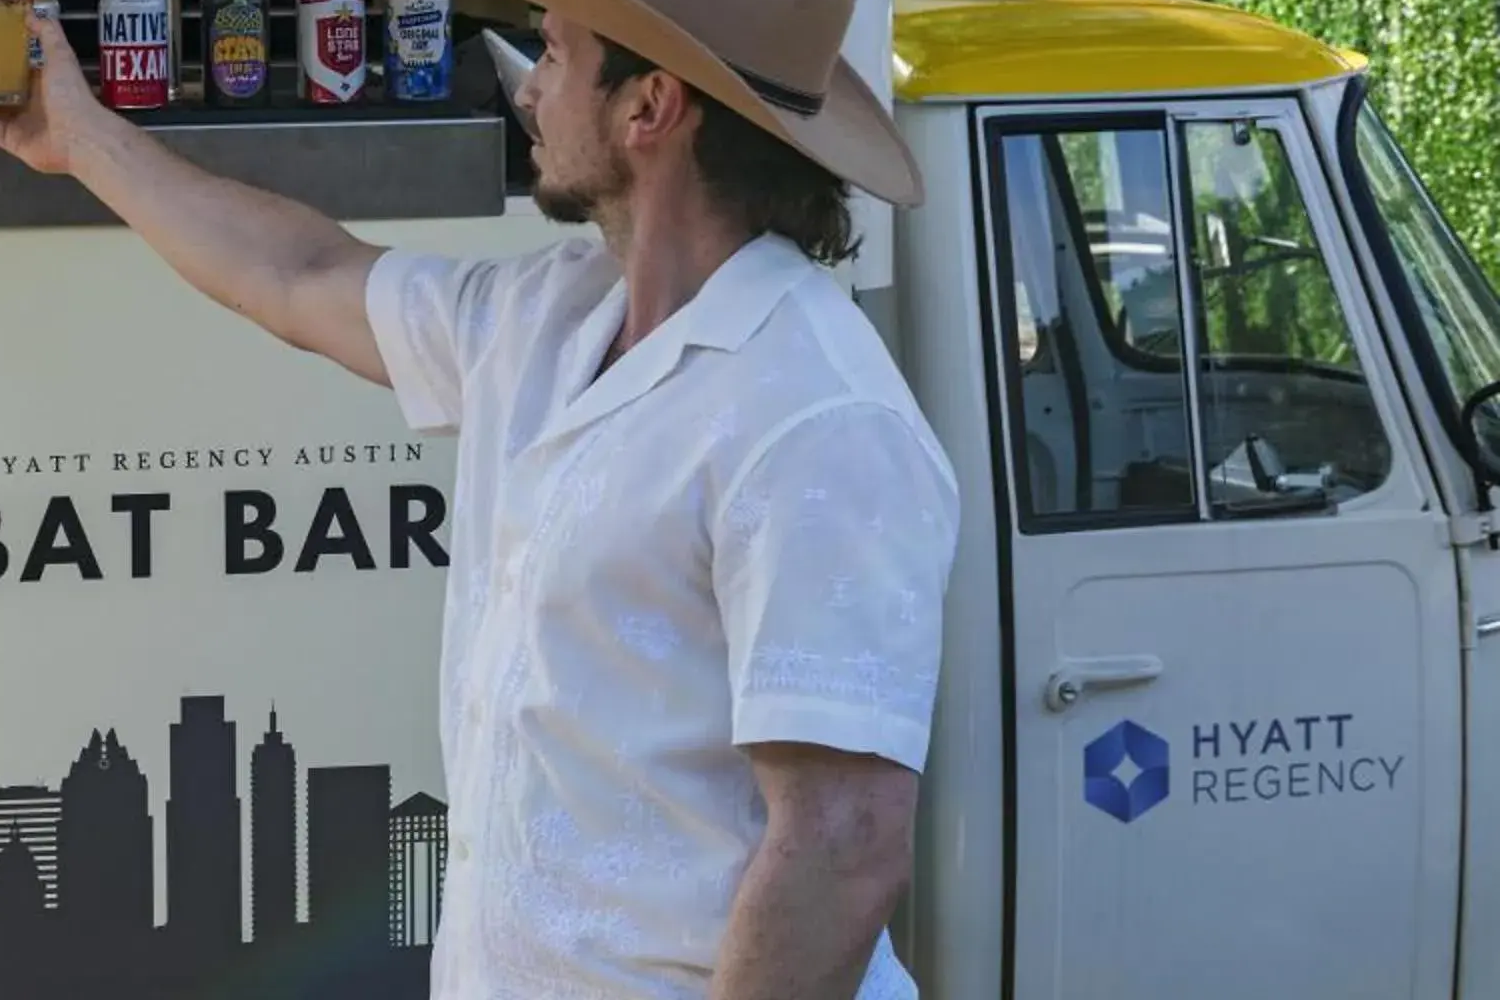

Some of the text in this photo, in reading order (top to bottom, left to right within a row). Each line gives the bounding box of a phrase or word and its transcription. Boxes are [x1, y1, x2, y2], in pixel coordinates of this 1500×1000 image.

[102, 12, 168, 42] NATIVE
[102, 48, 168, 81] TEXAN
[112, 447, 274, 471] REGENCY
[294, 443, 423, 465] AUSTIN
[223, 483, 450, 575] BAR
[1192, 713, 1354, 759] HYATT
[1192, 756, 1405, 805] REGENCY
